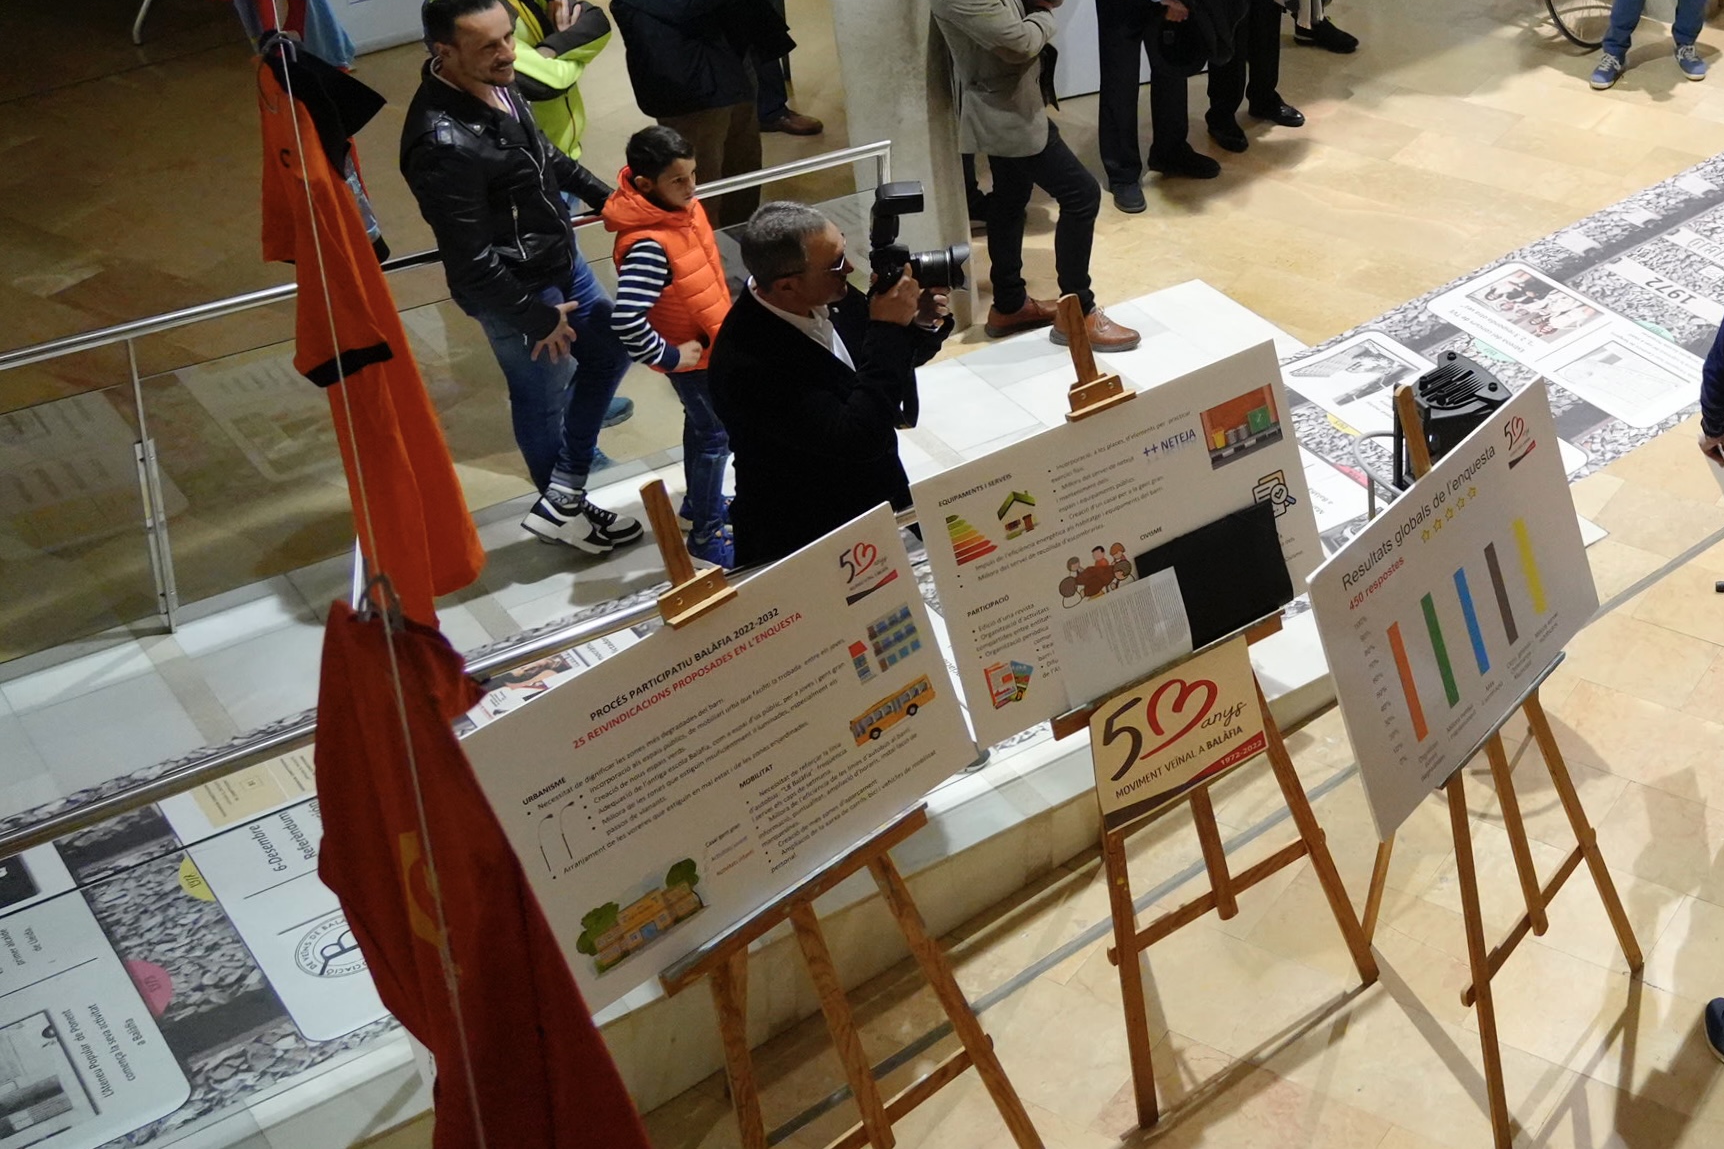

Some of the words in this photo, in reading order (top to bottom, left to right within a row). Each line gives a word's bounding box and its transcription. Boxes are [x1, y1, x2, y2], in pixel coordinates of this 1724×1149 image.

[1644, 276, 1699, 305] 1972
[1161, 429, 1196, 451] NETEJA
[938, 485, 984, 507] EQUIPAMENTS
[988, 474, 1012, 486] SERVEIS
[1342, 540, 1393, 591] Resultats
[1395, 505, 1431, 547] globals
[1433, 491, 1446, 509] de
[1446, 446, 1495, 496] l'enquesta
[1140, 526, 1162, 540] CIVISME
[1350, 592, 1364, 610] 450
[1365, 557, 1404, 597] respostes
[967, 594, 1009, 617] PARTICIPACIÓ
[590, 694, 628, 721] PROCÉS
[629, 657, 693, 699] PARTICIPATIU
[694, 635, 732, 662] BALÀFIA
[733, 608, 779, 639] 2022-2032
[573, 737, 586, 749] 25
[587, 687, 671, 741] REIVINDICACIONS
[672, 652, 733, 692] PROPOSADES
[734, 643, 747, 656] EN
[748, 612, 802, 648] L'ENQUESTA
[1201, 702, 1247, 729] anys
[1116, 767, 1162, 799] MOVIMENT
[1165, 752, 1197, 772] VEÏNAL
[1199, 746, 1206, 755] A
[1206, 726, 1243, 750] BALÀFIA
[1221, 740, 1263, 766] 1972-2022
[739, 764, 772, 788] MOBILITAT
[522, 777, 566, 805] URBANISME
[275, 808, 318, 860] Referèndum
[249, 825, 287, 872] 6-Desembre
[61, 1009, 80, 1033] Ponent
[88, 1003, 108, 1030] activitat
[125, 1018, 143, 1042] Balàfia
[74, 1032, 85, 1041] de
[103, 1029, 116, 1045] seva
[110, 1044, 119, 1053] la
[81, 1044, 100, 1070] Popular
[115, 1051, 136, 1081] comença
